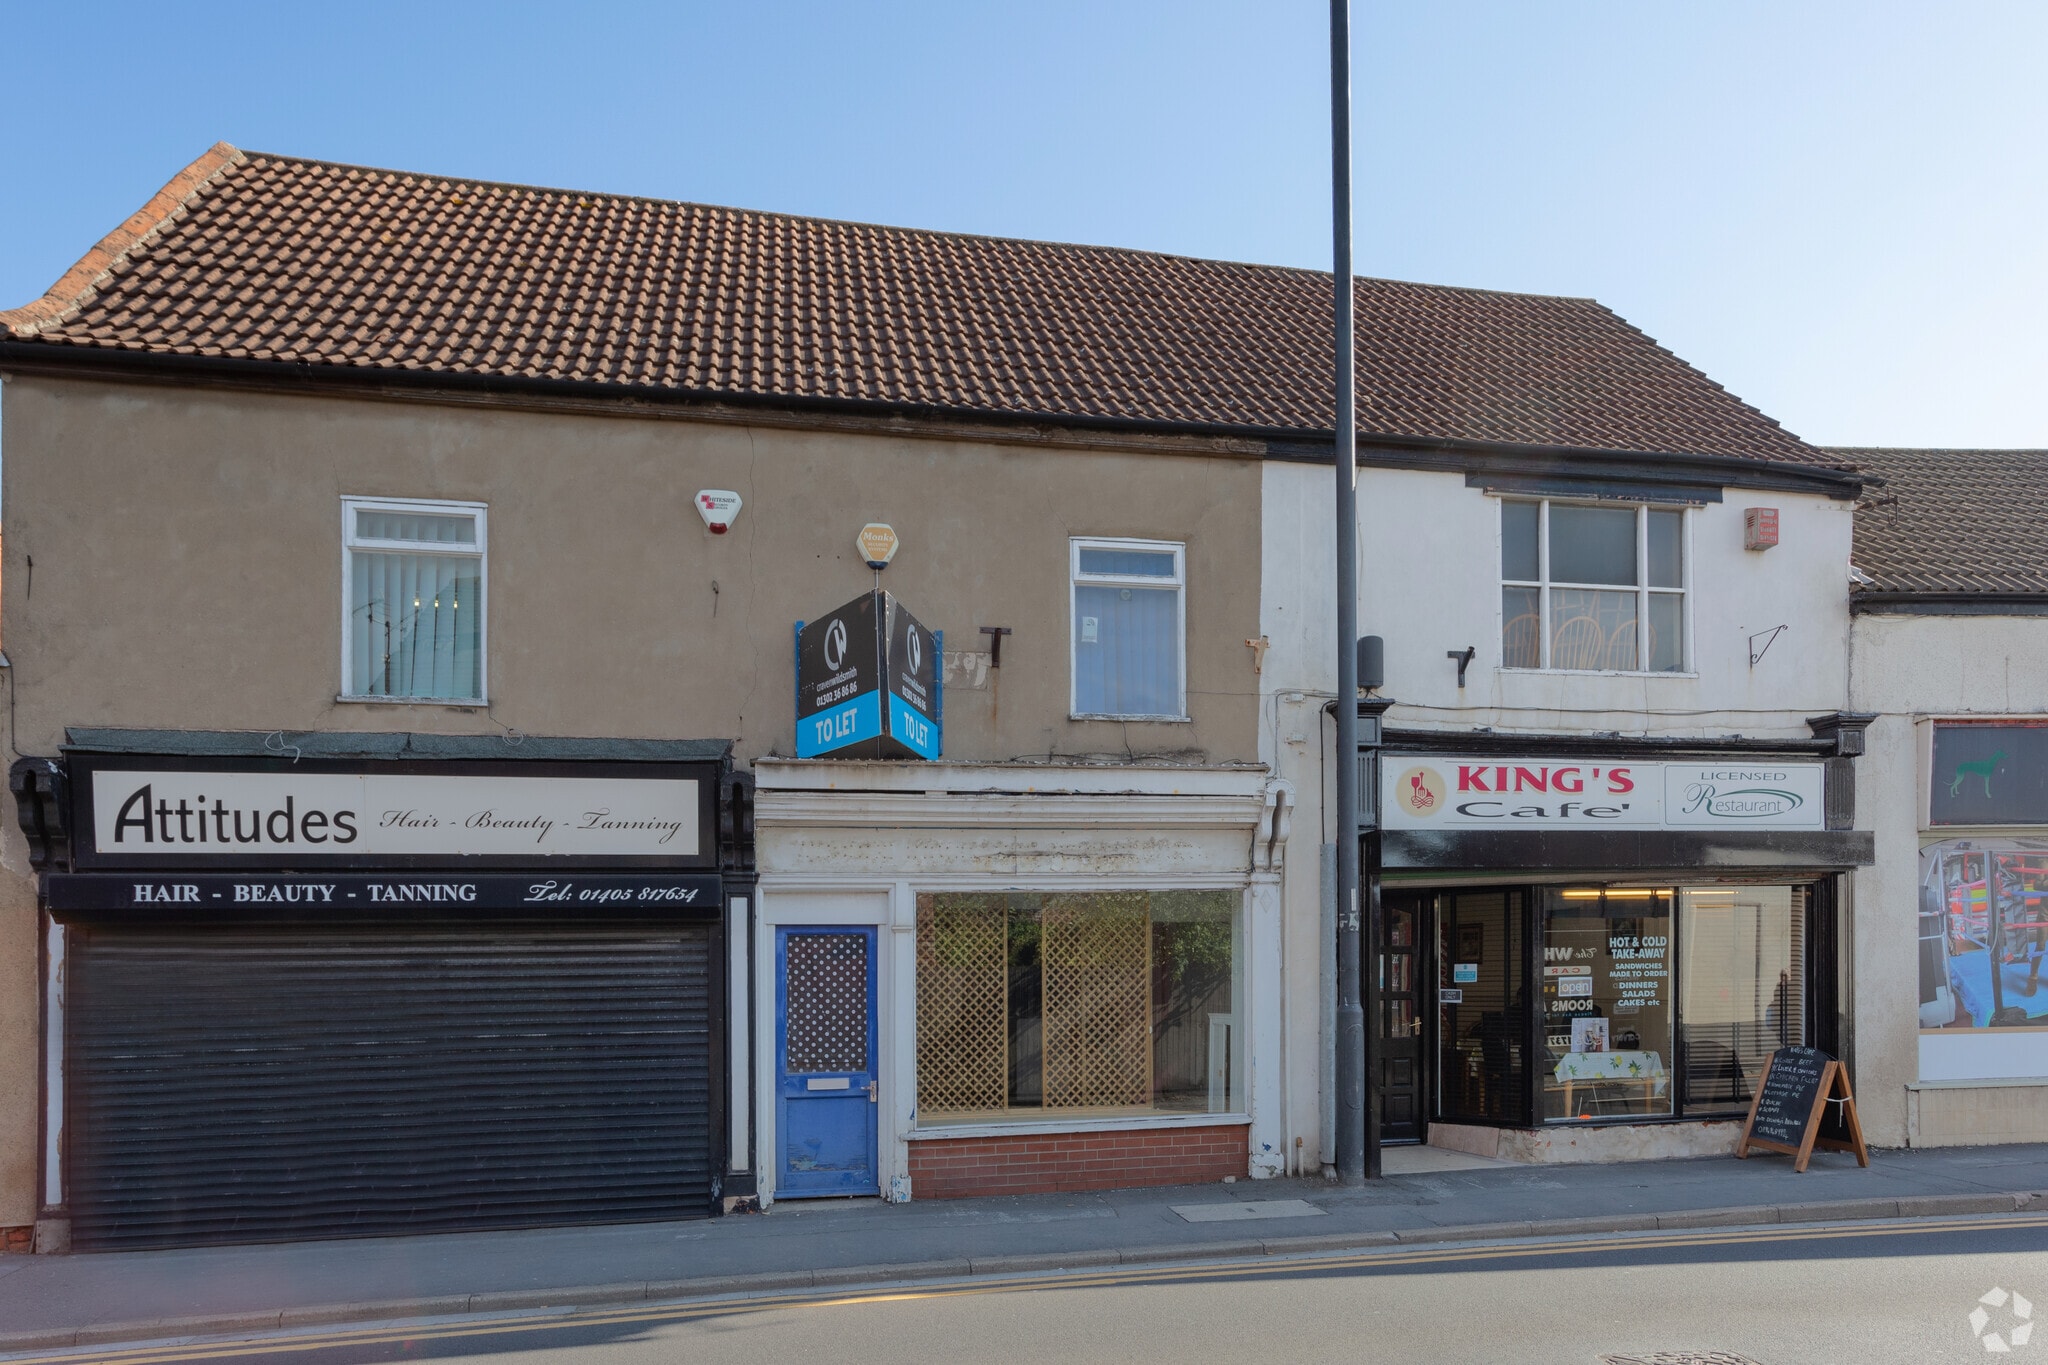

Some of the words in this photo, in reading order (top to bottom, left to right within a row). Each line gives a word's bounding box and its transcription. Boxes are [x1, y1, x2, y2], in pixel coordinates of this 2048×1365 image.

[863, 532, 895, 542] Monks
[816, 692, 833, 707] 01302
[833, 688, 841, 701] 36
[841, 684, 849, 697] 86
[849, 681, 858, 694] 86
[815, 718, 833, 745] TO
[836, 707, 858, 738] LET
[904, 711, 915, 740] TO
[915, 719, 929, 749] LET
[1457, 765, 1635, 794] KING'S
[1701, 771, 1787, 781] LICENSED
[1682, 783, 1782, 814] Restaurant
[114, 783, 358, 844] Attitudes
[379, 808, 441, 829] Hair
[465, 808, 554, 844] Beauty
[577, 807, 684, 845] Tanning
[133, 884, 201, 902] HAIR
[233, 884, 336, 902] BEAUTY
[367, 884, 477, 902] TANNING
[524, 880, 572, 902] Tel:
[579, 887, 634, 903] 01405
[637, 887, 700, 903] 817654
[1609, 937, 1630, 948] HOT
[1632, 937, 1639, 947] &
[1642, 936, 1667, 947] COLD
[1611, 948, 1665, 960] TAKE-AWAY
[1561, 982, 1589, 994] open
[1618, 981, 1658, 989] DINNERS
[1622, 990, 1656, 998] SALADS
